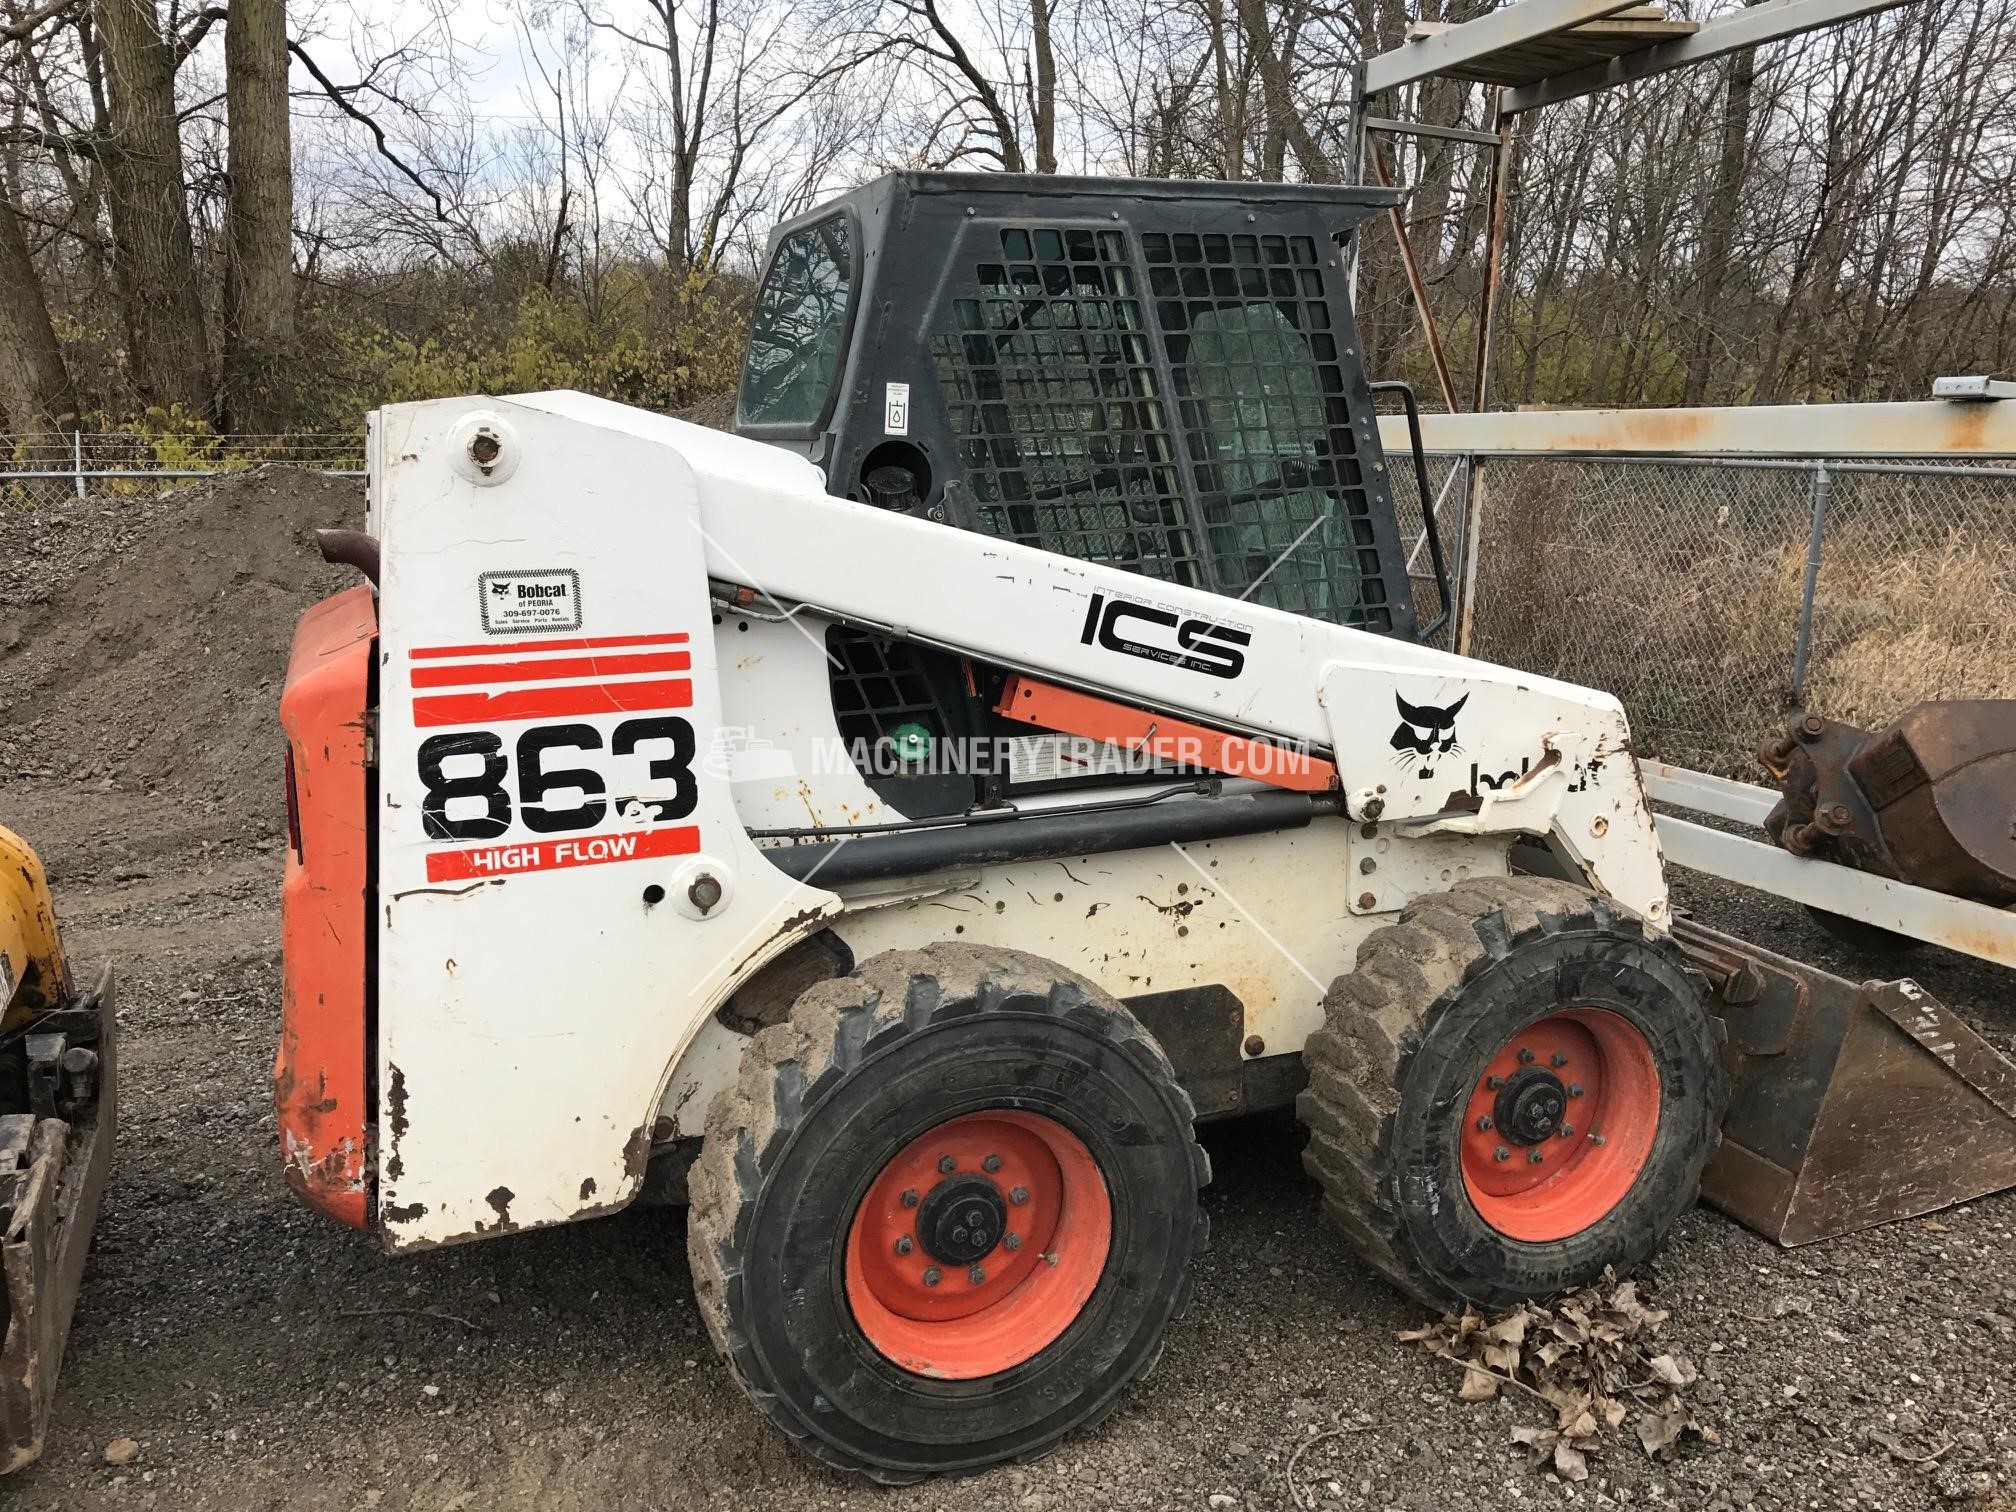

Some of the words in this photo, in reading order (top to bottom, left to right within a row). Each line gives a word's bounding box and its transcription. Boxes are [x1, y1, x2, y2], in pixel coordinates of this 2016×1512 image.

[517, 583, 567, 598] Bobcat
[528, 599, 554, 607] PEORIA
[503, 608, 561, 618] 309-697-0076
[1080, 593, 1252, 680] ICS
[1121, 642, 1188, 666] SERVICES
[1190, 659, 1213, 672] INC.
[417, 716, 699, 843] 863
[472, 846, 540, 871] HIGH
[554, 836, 637, 864] FLOW
